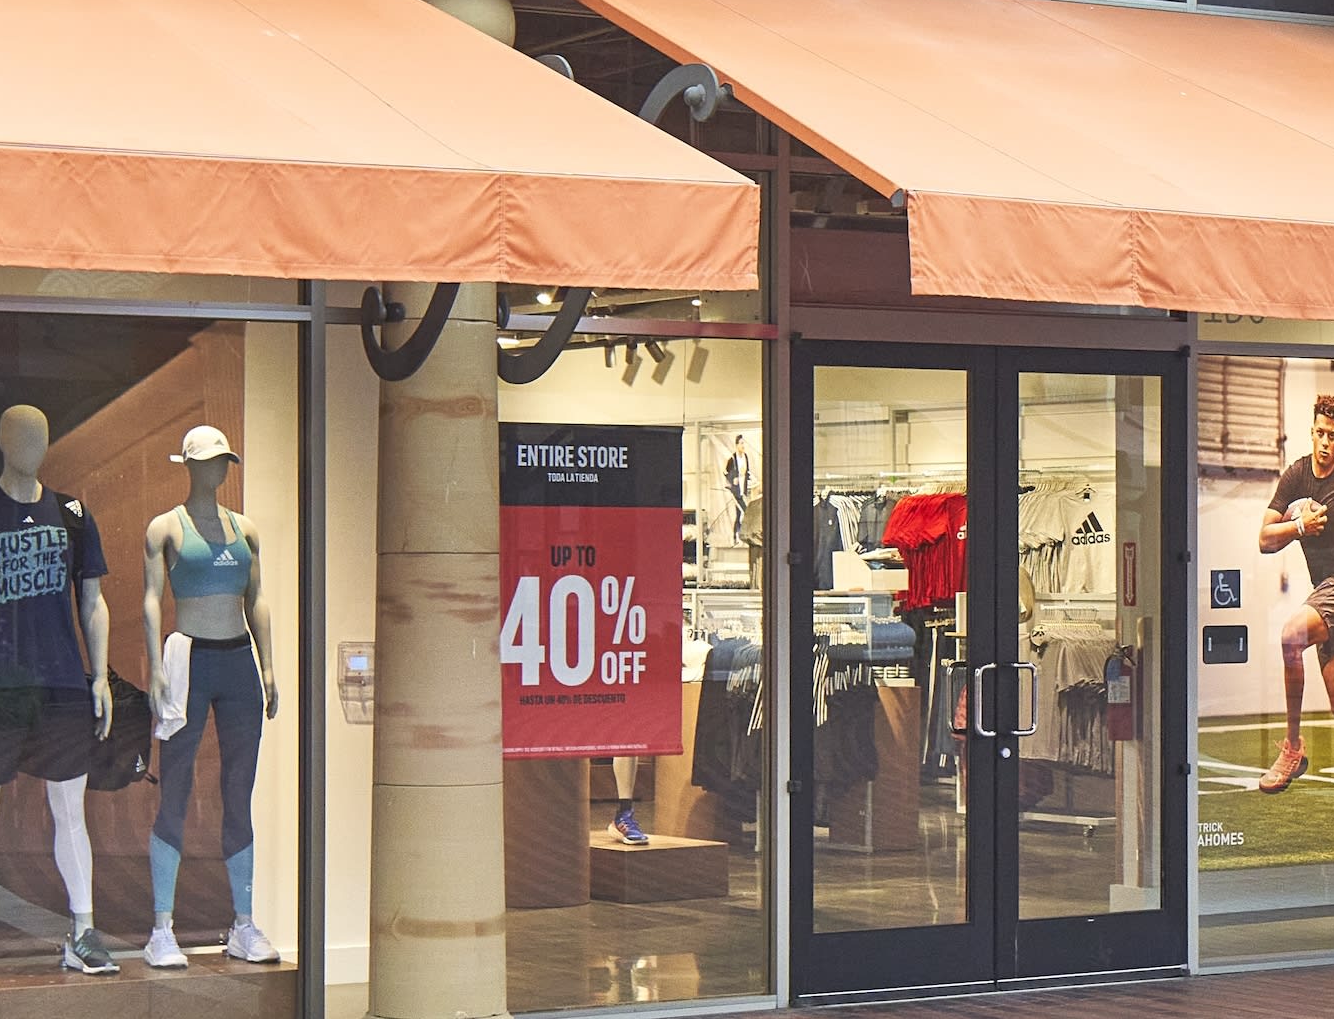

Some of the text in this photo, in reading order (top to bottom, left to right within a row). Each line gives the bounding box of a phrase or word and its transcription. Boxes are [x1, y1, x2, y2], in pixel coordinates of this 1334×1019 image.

[518, 445, 628, 468] ENTIRE STORE
[547, 473, 598, 482] TODA LA TIENDA
[1072, 533, 1110, 545] adidas
[2, 550, 58, 574] FOR THE
[551, 546, 595, 566] UP TO
[500, 575, 646, 686] 40%
[600, 651, 646, 685] OFF
[1197, 822, 1223, 833] TRICK
[1197, 832, 1244, 847] AHOMES
